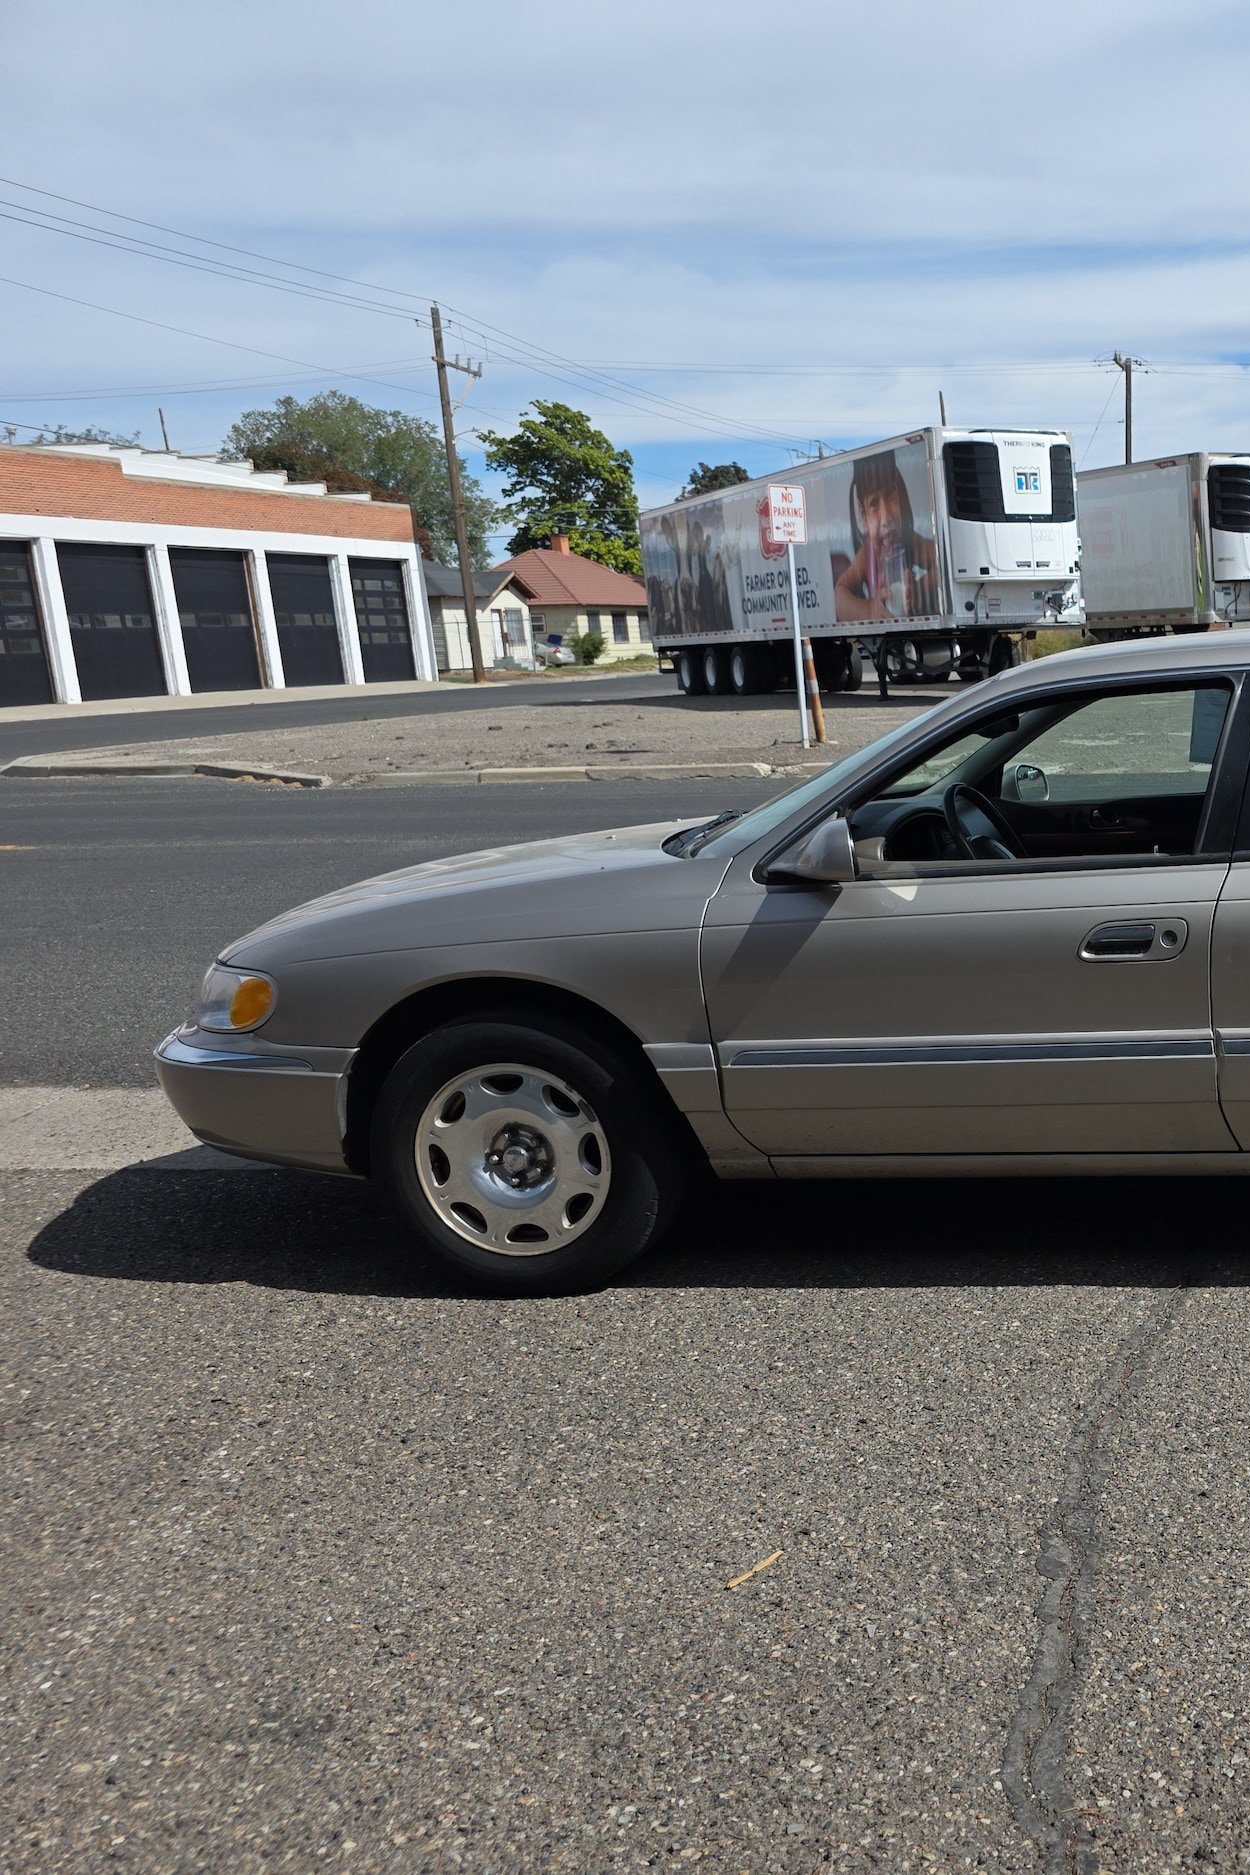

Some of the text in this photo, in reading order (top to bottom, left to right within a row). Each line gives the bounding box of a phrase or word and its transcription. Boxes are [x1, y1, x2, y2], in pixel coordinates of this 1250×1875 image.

[781, 492, 793, 503] NO
[773, 506, 803, 518] PARKING
[746, 567, 811, 593] FARMER OWED.
[741, 593, 788, 614] COMMUNITY
